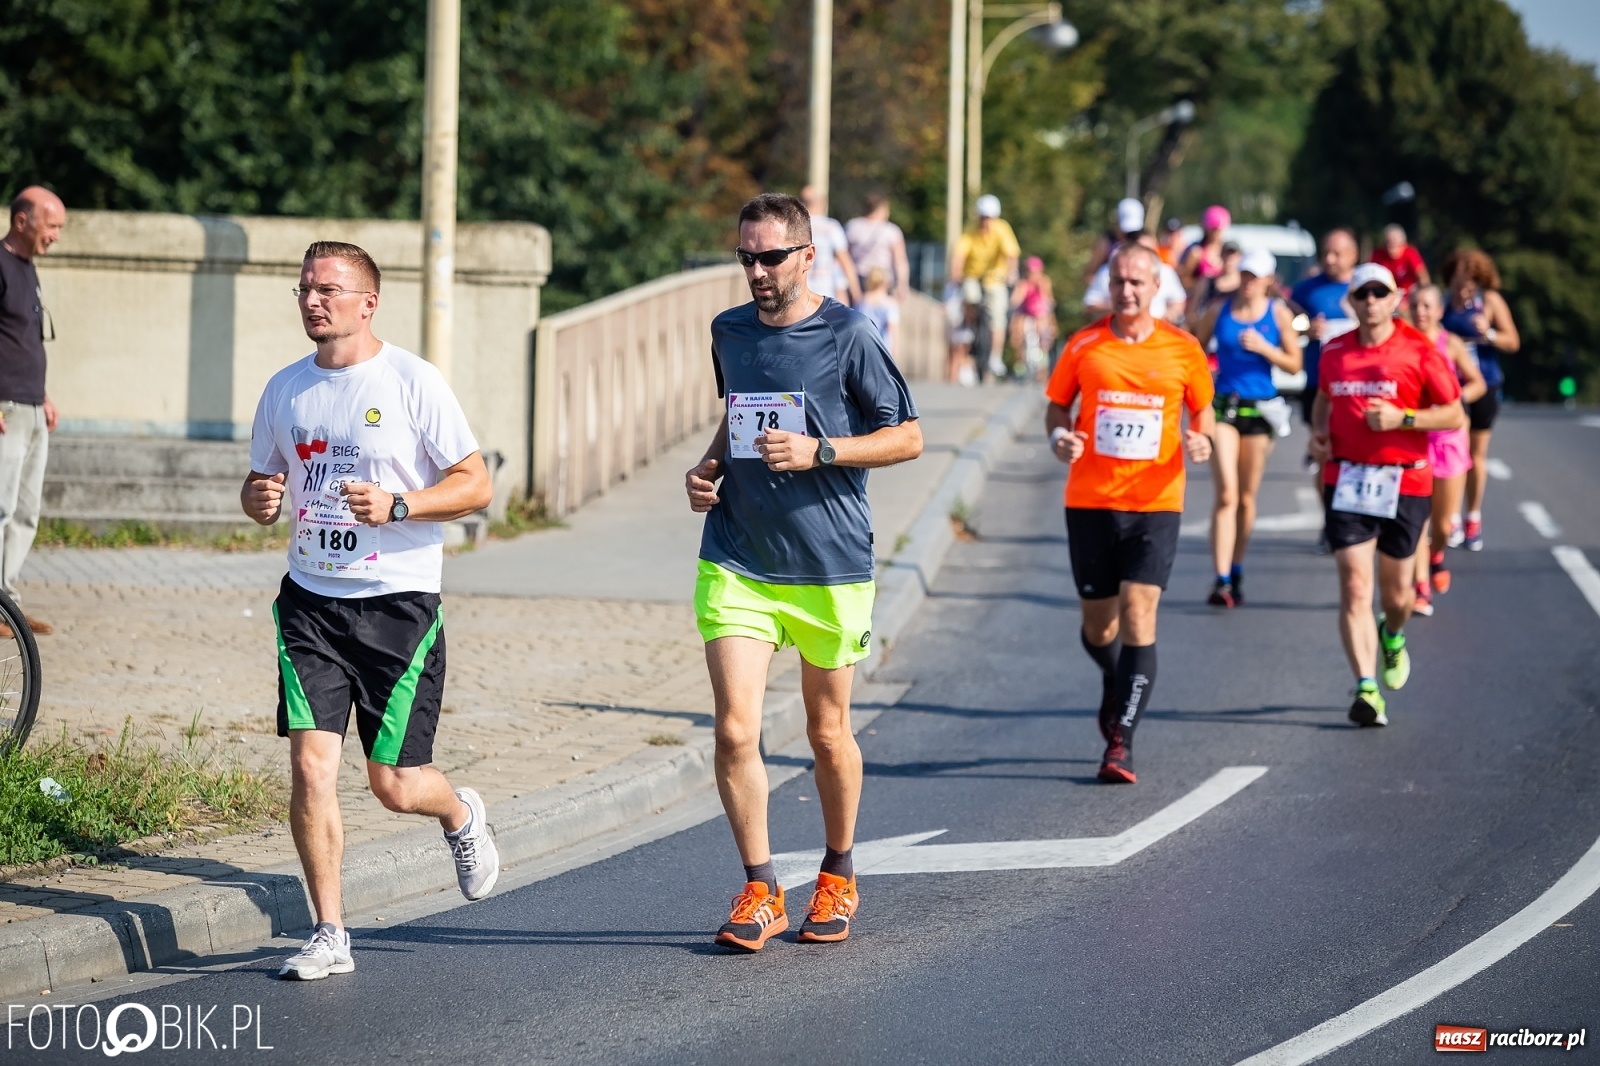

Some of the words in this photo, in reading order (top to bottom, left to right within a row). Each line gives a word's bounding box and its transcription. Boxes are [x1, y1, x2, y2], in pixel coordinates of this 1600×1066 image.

[1097, 389, 1165, 409] DECATHLON
[755, 410, 779, 432] 78
[1114, 423, 1145, 438] 277
[331, 445, 360, 459] BIEG
[302, 461, 327, 492] XII
[331, 463, 356, 474] BEZ
[318, 528, 357, 552] 180
[1120, 674, 1150, 728] Kalenji
